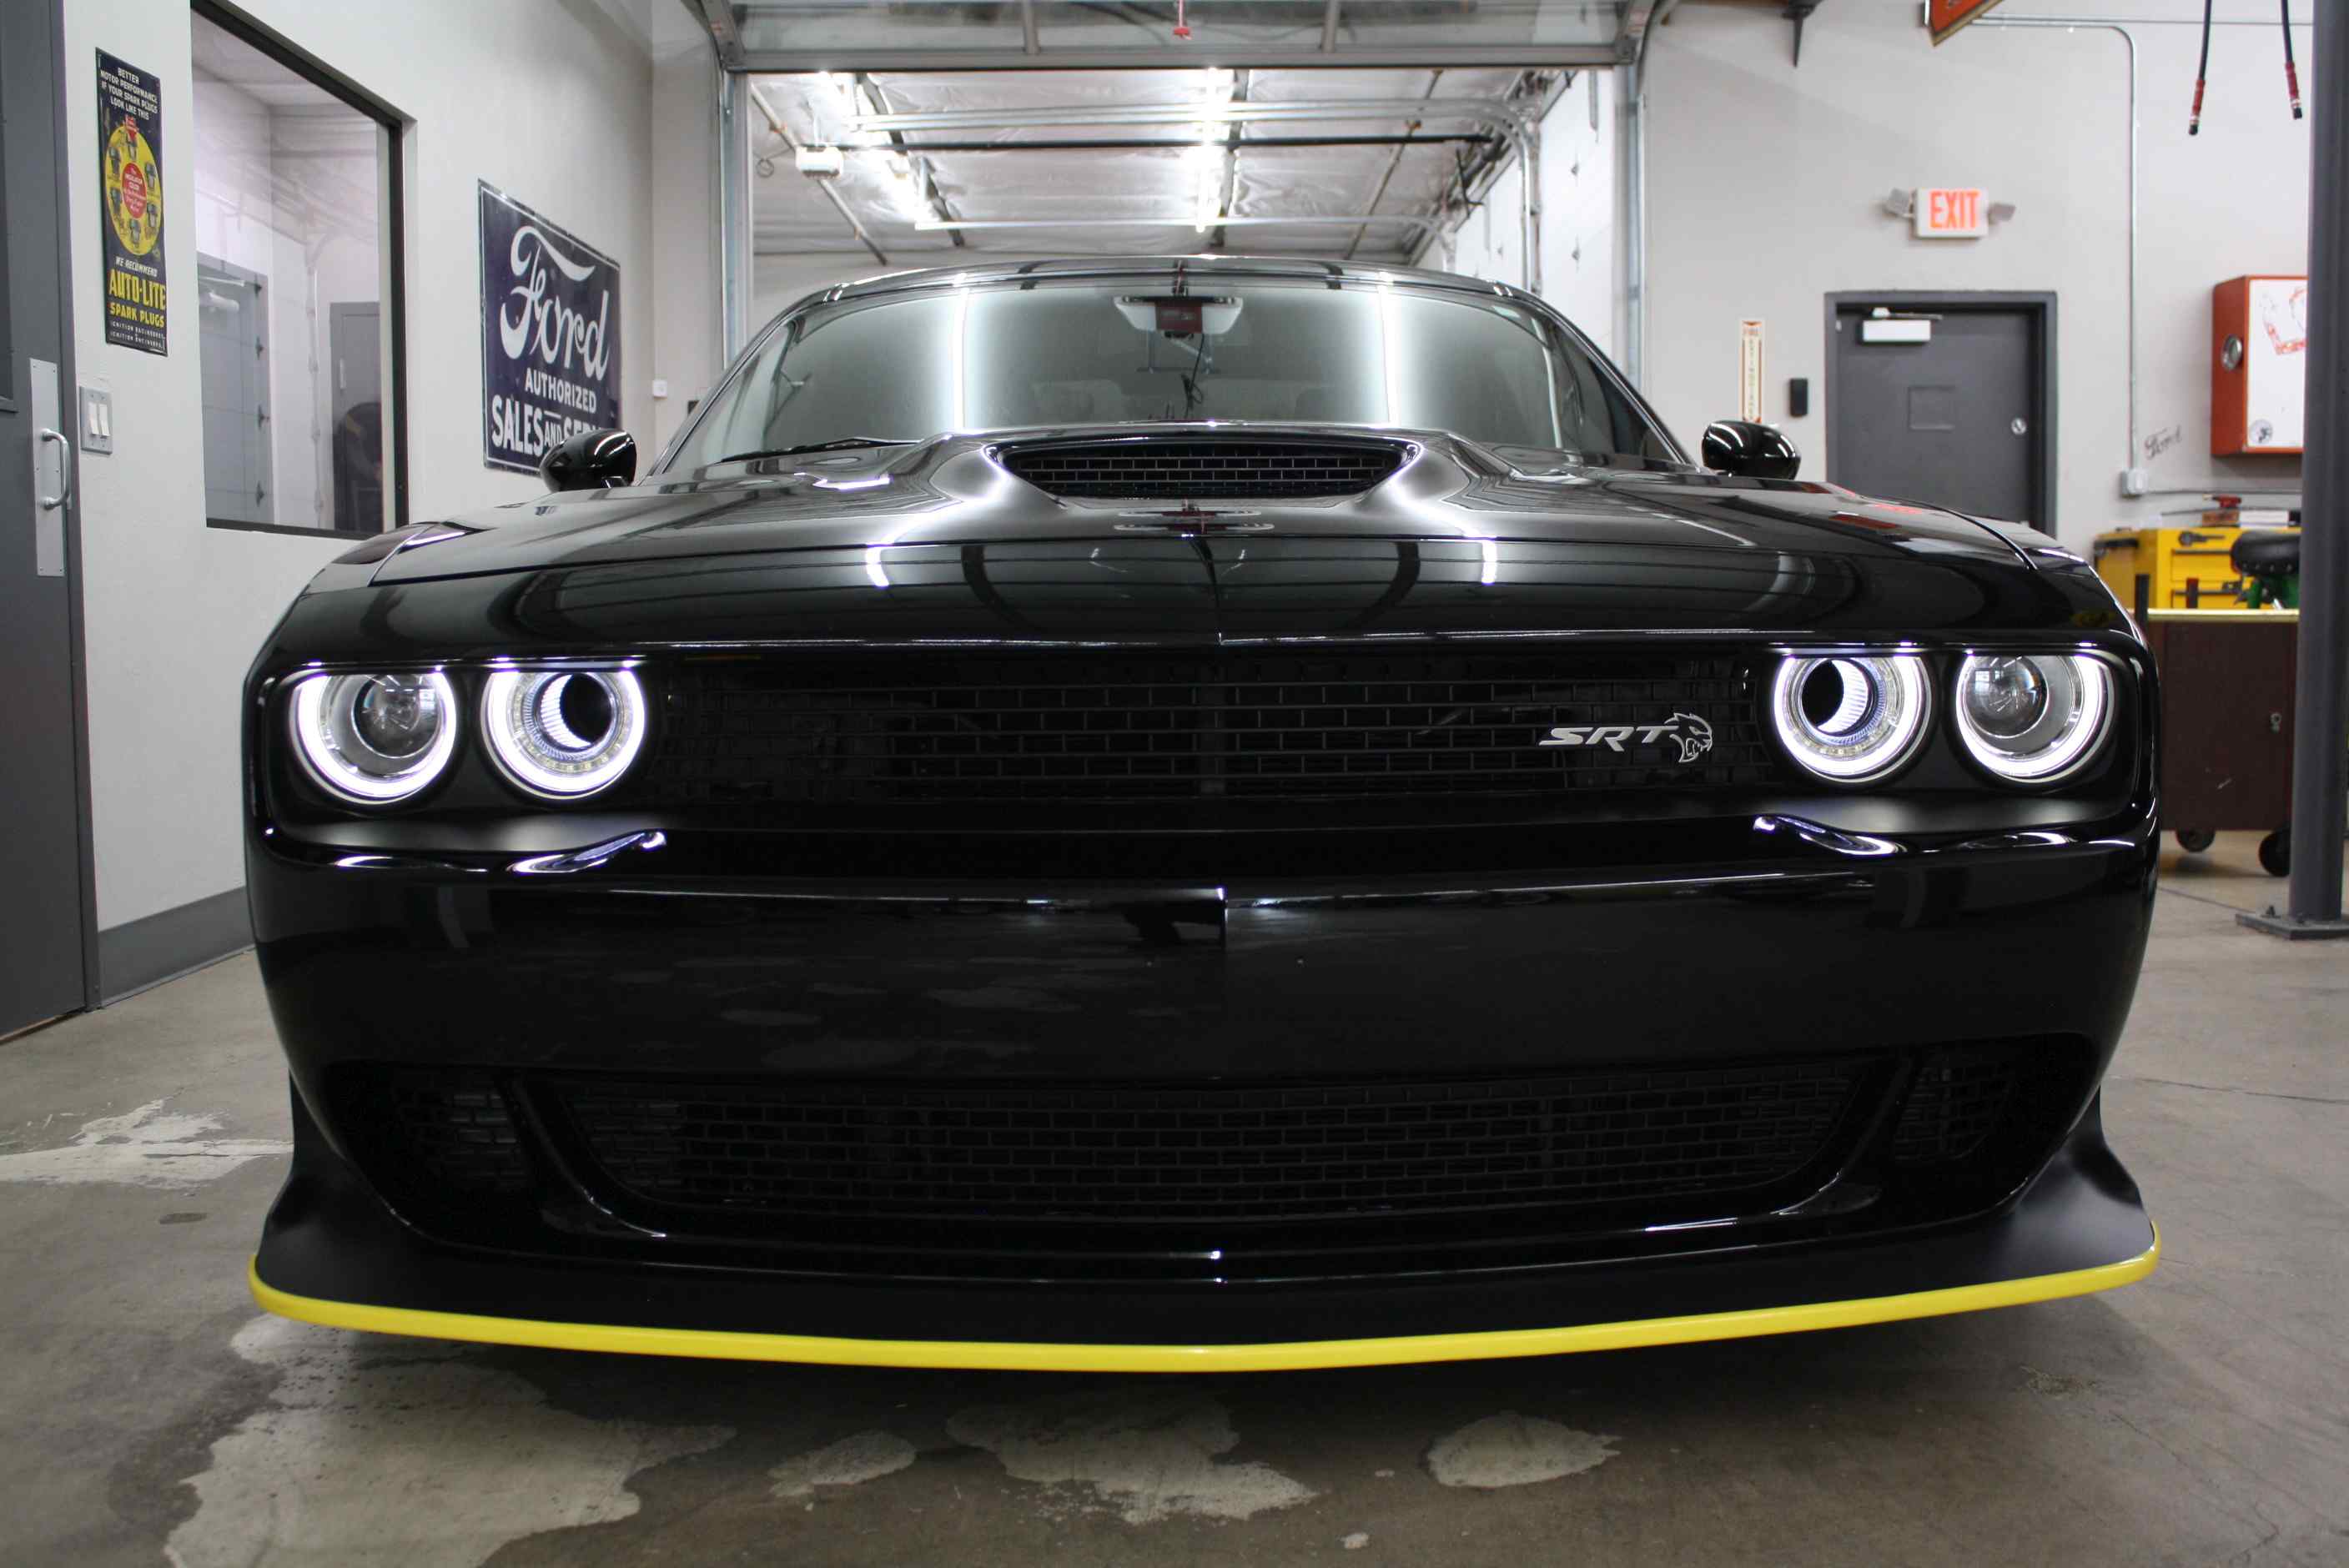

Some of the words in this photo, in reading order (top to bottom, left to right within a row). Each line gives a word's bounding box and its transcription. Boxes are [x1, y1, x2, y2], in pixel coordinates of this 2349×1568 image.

[100, 68, 119, 83] MOTOR
[118, 67, 139, 84] BETTER
[108, 84, 123, 98] YOUR
[123, 92, 141, 107] SPARK
[141, 98, 158, 114] PLUGS
[110, 95, 125, 109] LOOK
[125, 100, 137, 115] LIKE
[137, 108, 149, 121] THIS
[1929, 189, 1981, 229] EXIT
[115, 255, 124, 267] WE
[125, 259, 158, 278] RECOMMEND
[109, 301, 138, 321] SPARK
[139, 309, 165, 329] PLUGS
[500, 225, 610, 381] Ford
[525, 367, 597, 414] AUTHORIZED
[491, 395, 543, 457] SALES
[1538, 726, 1679, 751] SRT
